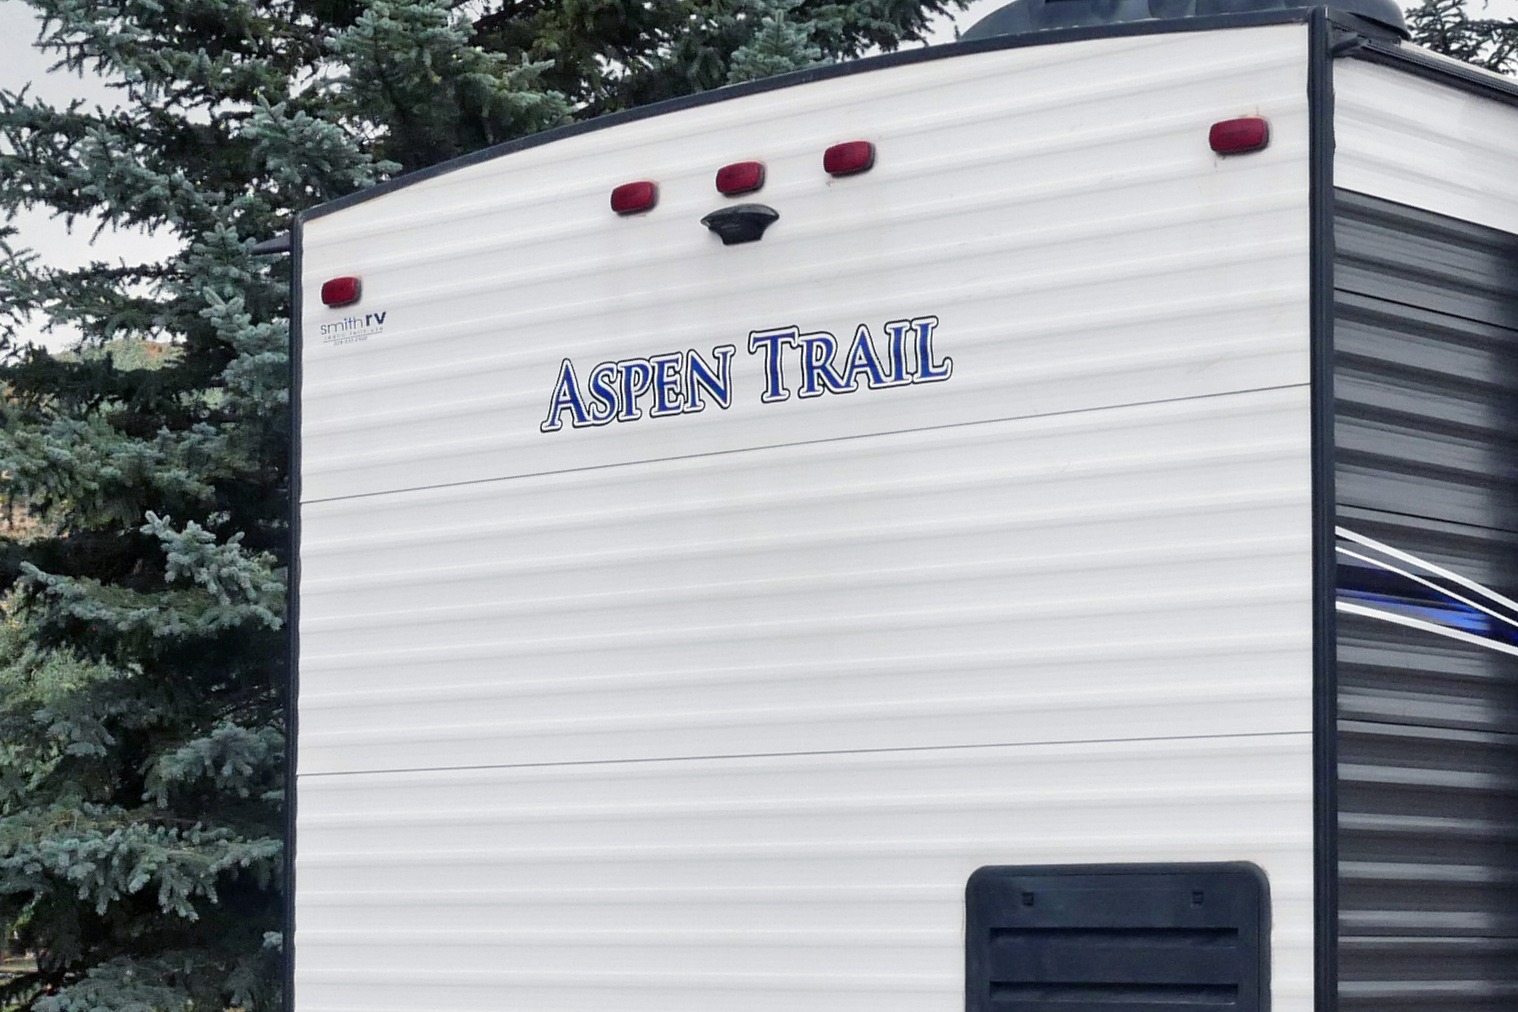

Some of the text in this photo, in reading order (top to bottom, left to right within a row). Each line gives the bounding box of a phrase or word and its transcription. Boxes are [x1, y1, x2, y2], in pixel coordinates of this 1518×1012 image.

[320, 311, 387, 336] smith rv
[540, 316, 954, 432] ASPEN TRAIL
